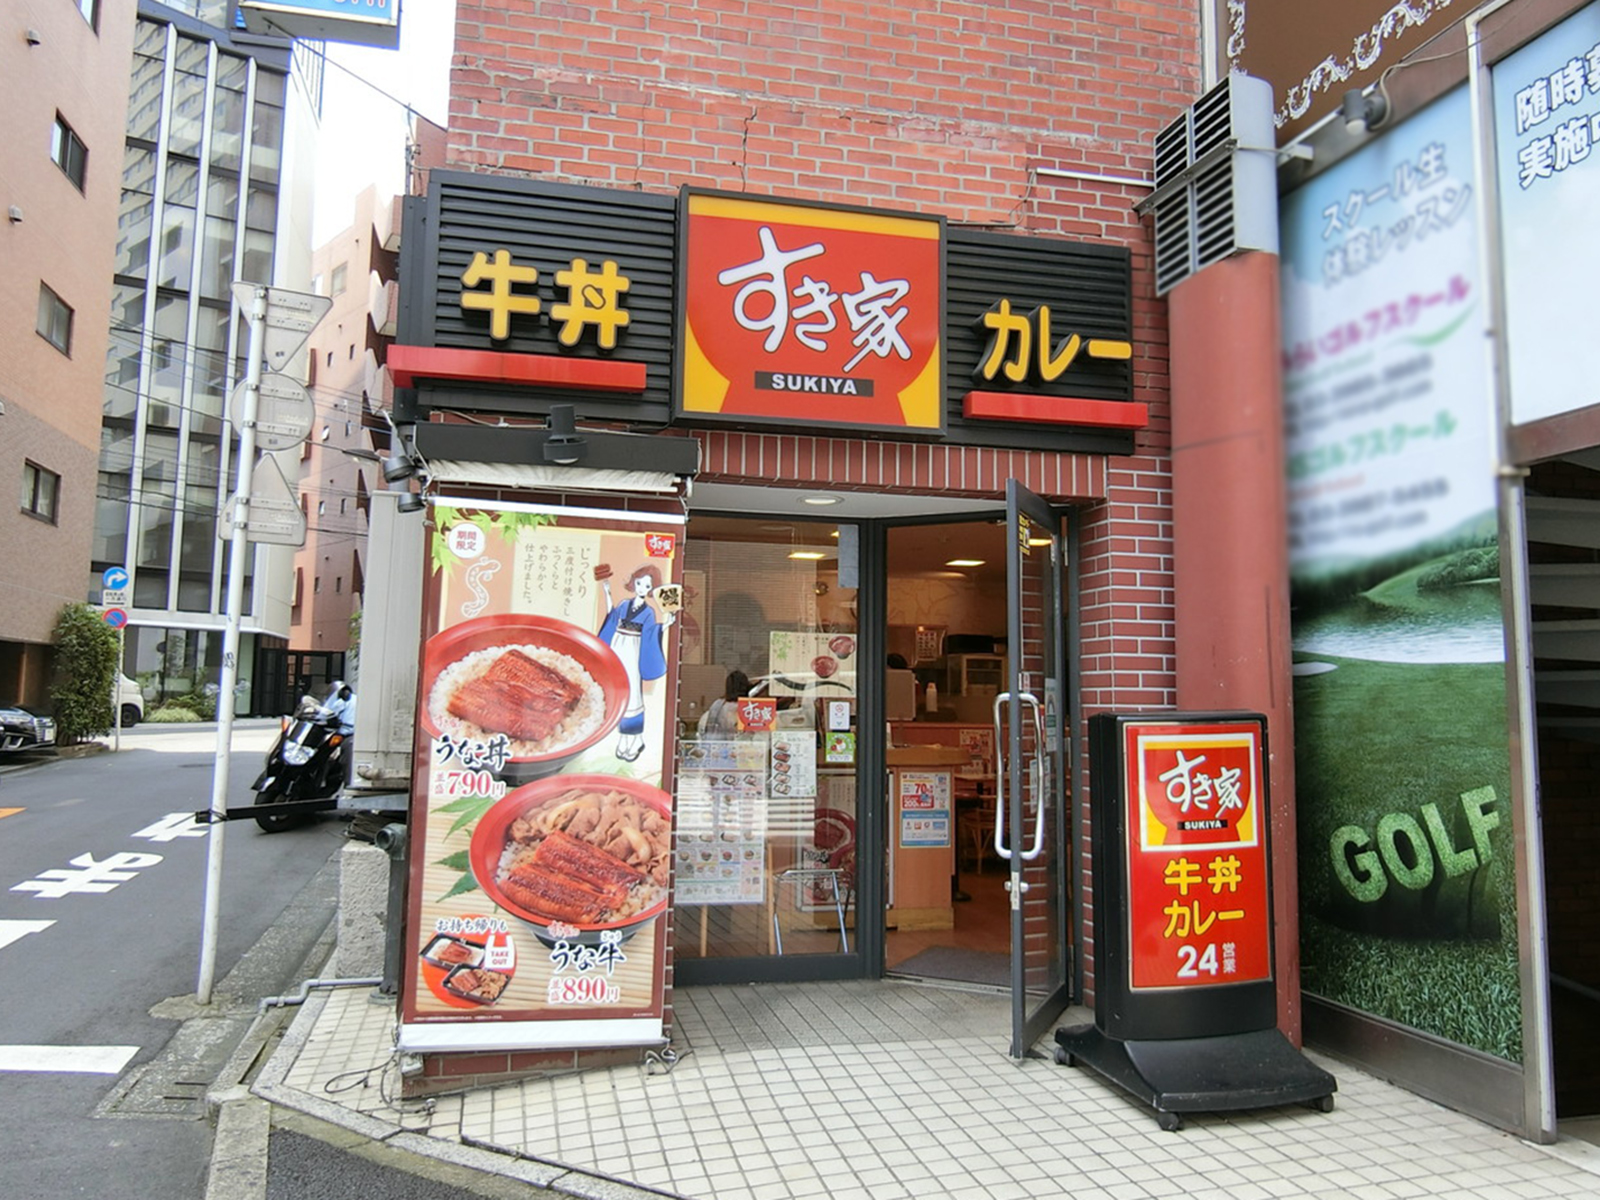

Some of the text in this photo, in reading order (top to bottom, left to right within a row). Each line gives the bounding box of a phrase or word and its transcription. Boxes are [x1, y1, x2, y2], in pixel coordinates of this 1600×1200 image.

[461, 249, 631, 350] 牛丼
[718, 226, 911, 373] すき家
[983, 299, 1132, 384] カレー
[771, 373, 857, 395] SUKIYA
[1159, 750, 1242, 818] すき家
[1184, 820, 1222, 829] SUKIYA
[1330, 785, 1499, 902] GOLF
[1164, 854, 1242, 895] 牛丼
[1163, 899, 1244, 938] カレー
[552, 942, 625, 974] うな牛
[1177, 943, 1218, 977] 24
